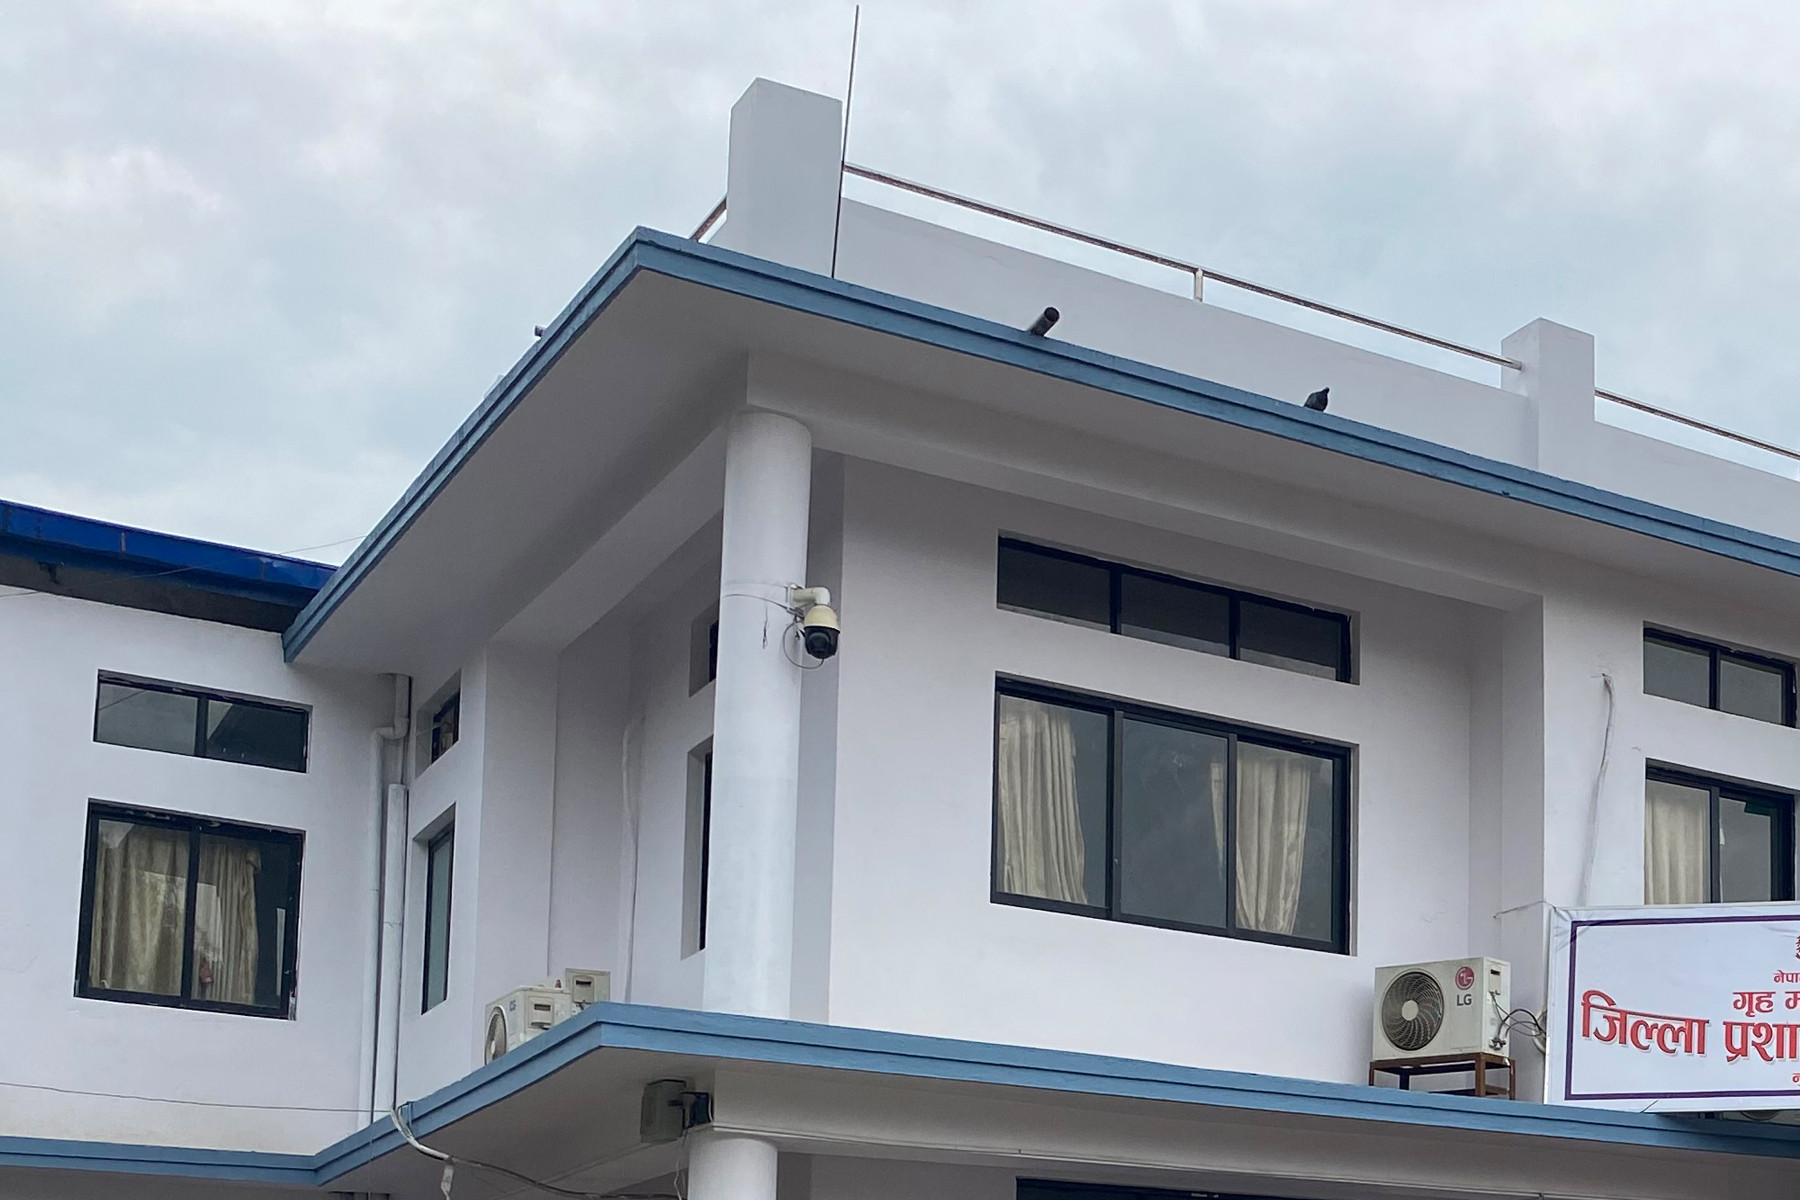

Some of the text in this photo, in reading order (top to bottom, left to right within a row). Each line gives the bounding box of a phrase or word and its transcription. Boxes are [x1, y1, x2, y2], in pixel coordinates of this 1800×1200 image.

[1457, 994, 1471, 1006] LG
[1733, 991, 1774, 1017] गृह
[1582, 990, 1709, 1054] जिल्ला
